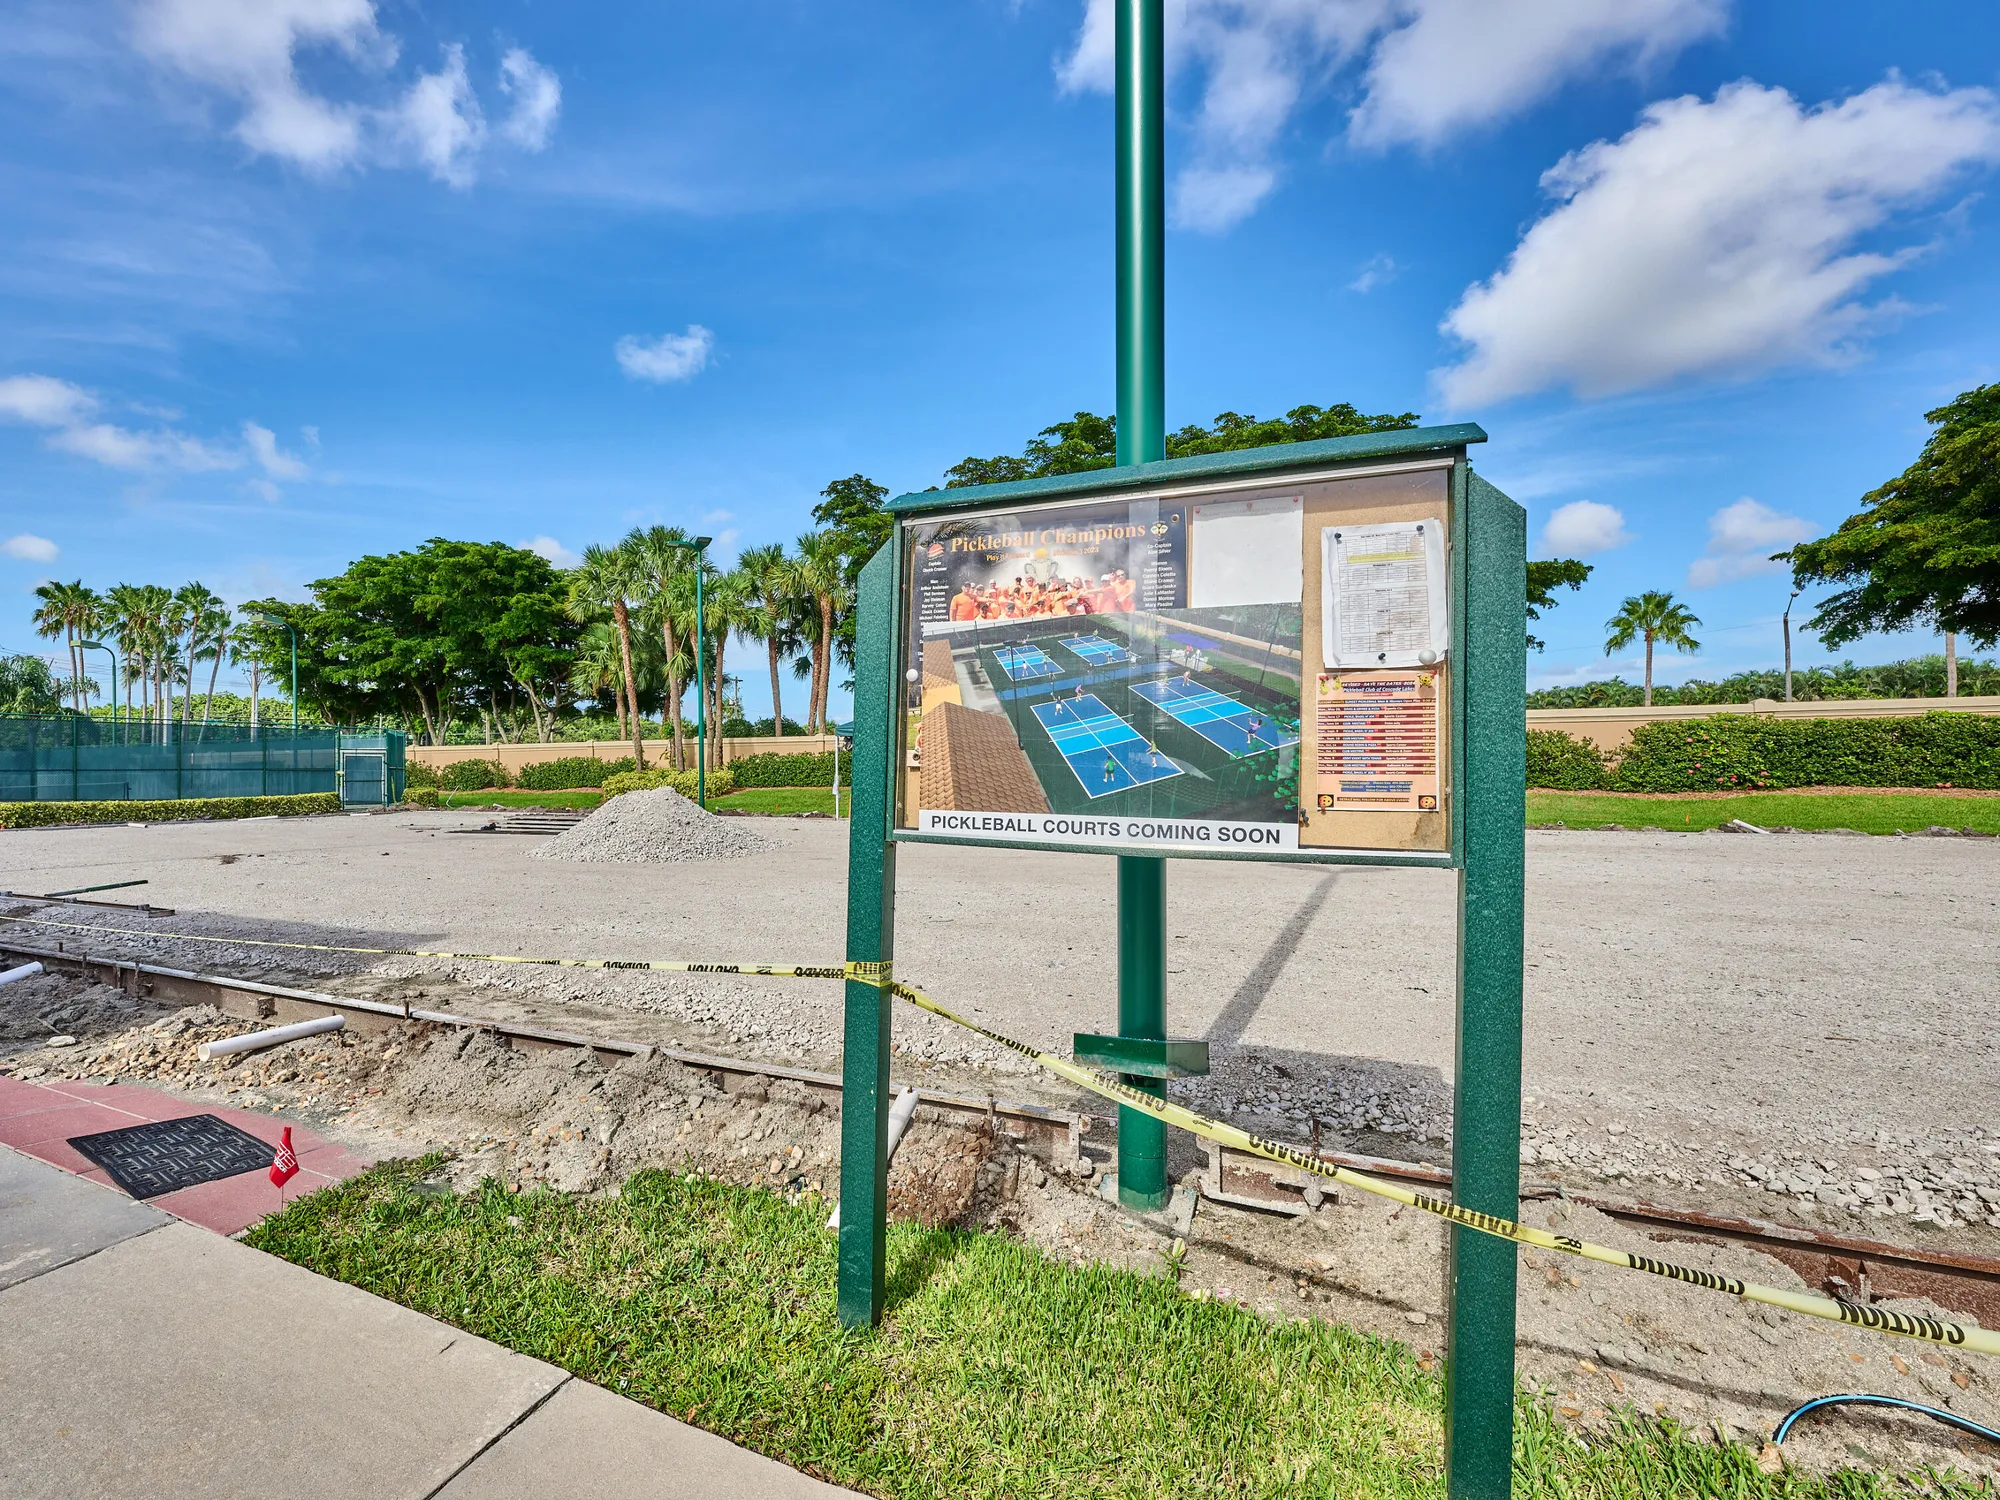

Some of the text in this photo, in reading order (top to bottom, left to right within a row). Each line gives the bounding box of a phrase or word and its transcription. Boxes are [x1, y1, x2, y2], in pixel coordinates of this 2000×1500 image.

[950, 523, 1146, 553] Pickleball Champions
[1084, 546, 1099, 554] 2023
[931, 815, 1280, 844] PICKLEBALL COURTS COMING SOON
[1249, 1134, 1340, 1177] CUIDADO
[1413, 1193, 1518, 1238] CAUTION
[1835, 1300, 1966, 1345] CAUTION
